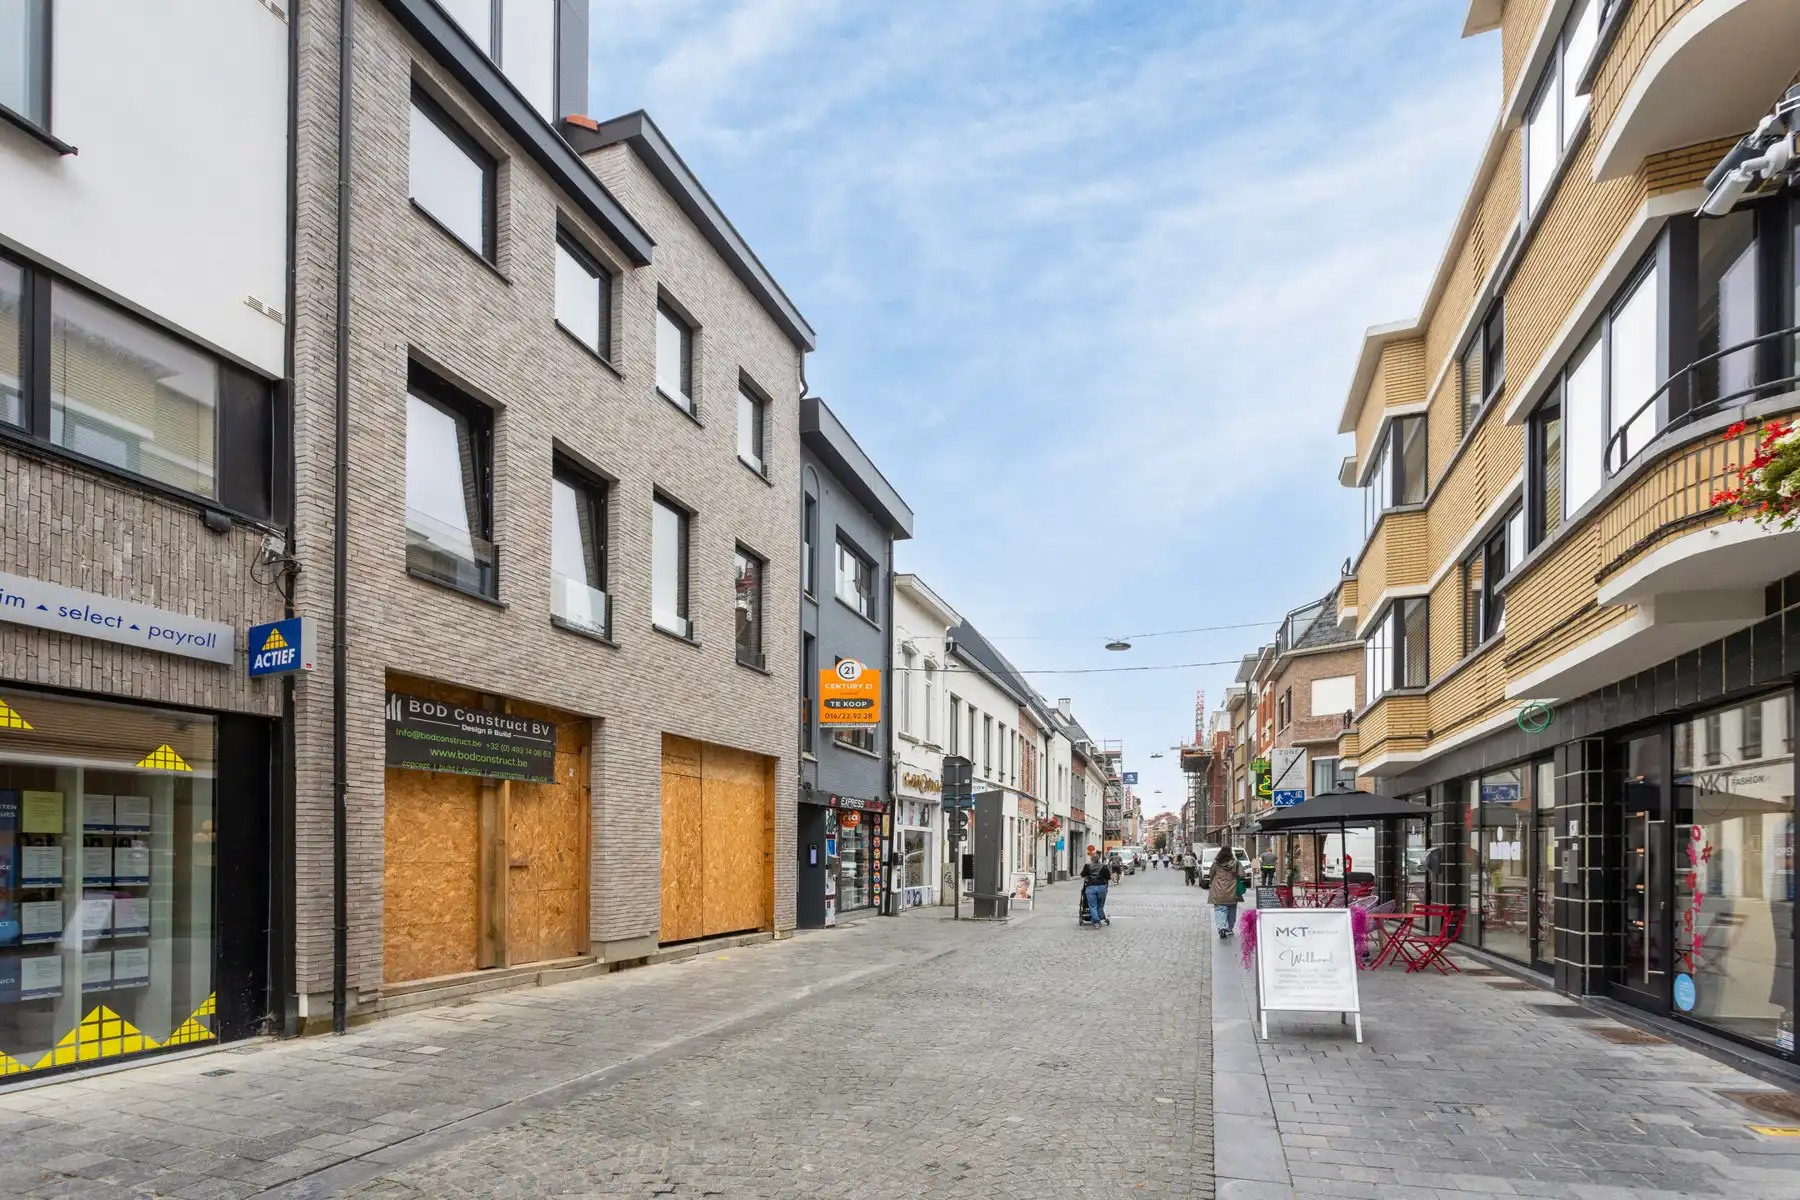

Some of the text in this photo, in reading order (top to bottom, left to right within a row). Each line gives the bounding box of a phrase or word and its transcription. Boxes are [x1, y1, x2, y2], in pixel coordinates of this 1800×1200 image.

[58, 605, 124, 629] select
[148, 623, 216, 649] payroll
[254, 647, 296, 670] ACTIEF
[409, 700, 550, 736] BOD Construct BV
[461, 724, 486, 735] Design
[494, 729, 512, 738] Build
[430, 748, 528, 768] www.bodconstruct.be
[500, 744, 510, 753] (0)
[1700, 771, 1764, 796] MKT FASHION
[841, 797, 865, 808] EXPRESS
[1276, 926, 1308, 937] MKT
